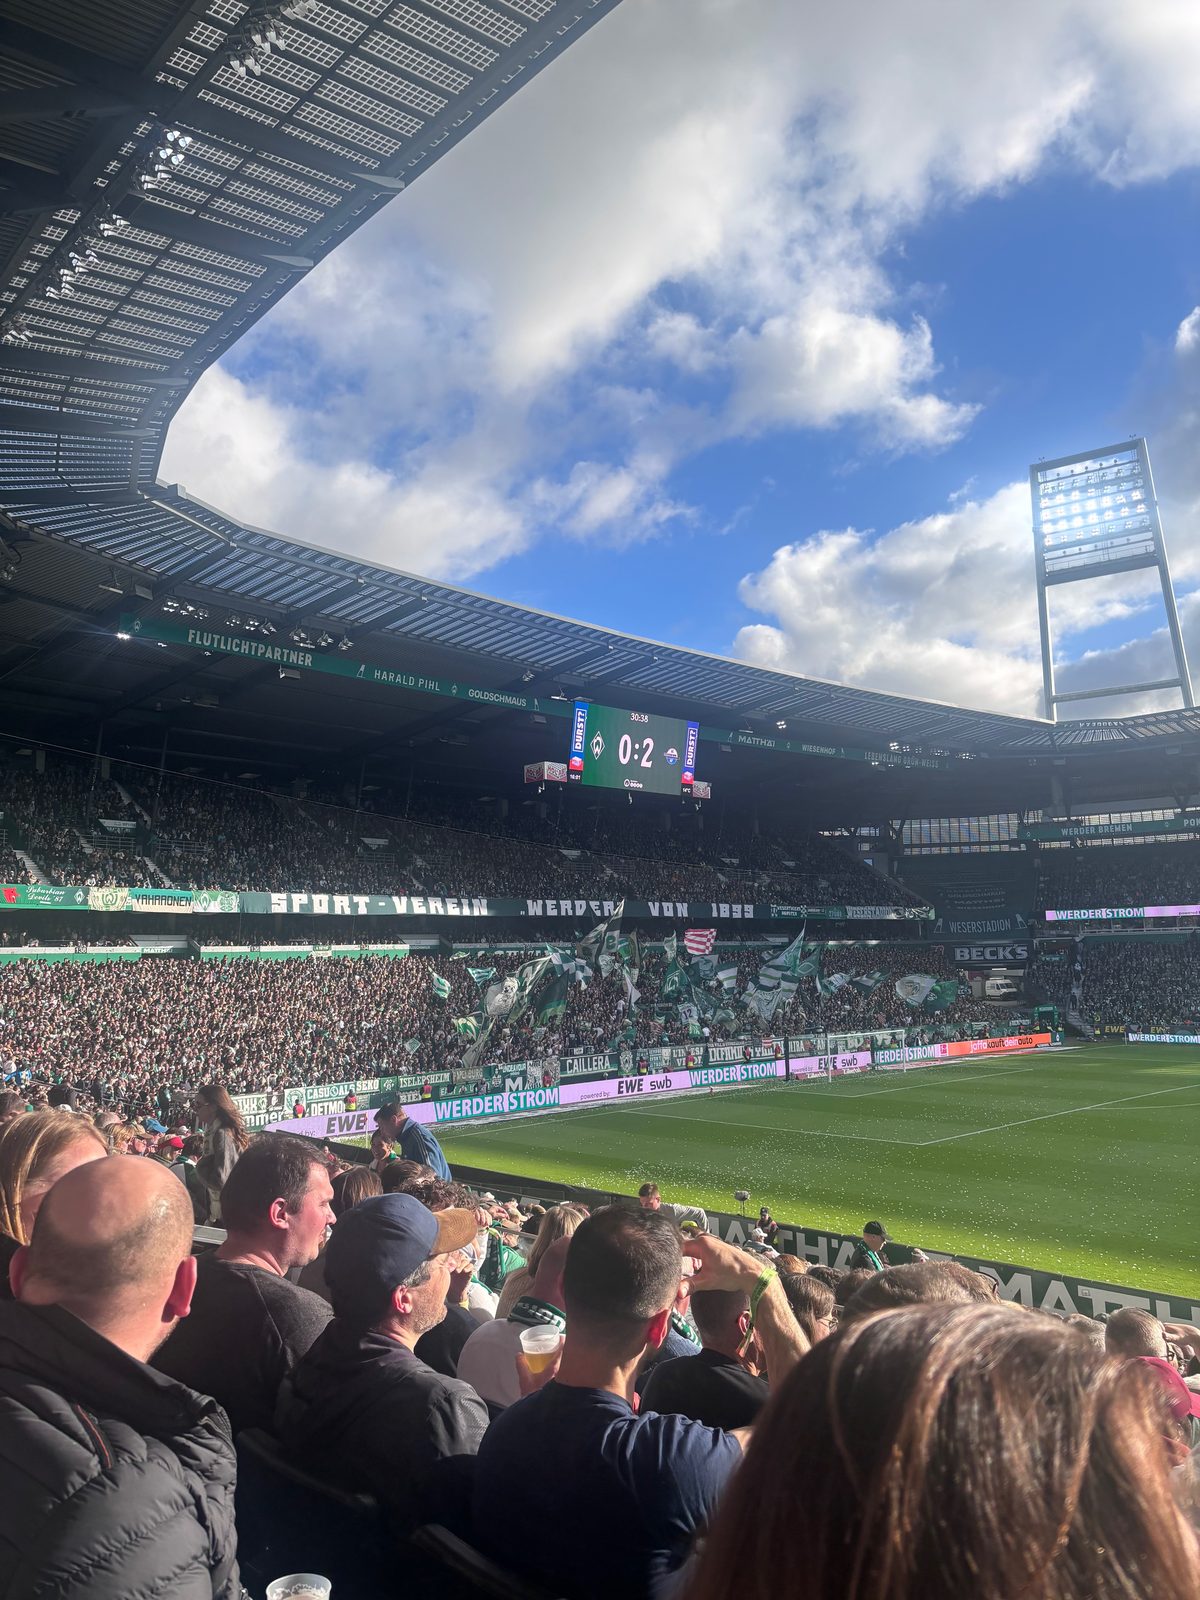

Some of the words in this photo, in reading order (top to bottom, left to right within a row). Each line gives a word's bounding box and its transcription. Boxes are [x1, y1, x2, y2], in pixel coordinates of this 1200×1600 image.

[188, 629, 313, 667] FLUTLICHTPARTNER
[374, 669, 415, 686] HARALD
[418, 678, 441, 692] PIHL
[468, 688, 527, 707] GOLDSCHMAUS
[574, 711, 586, 750] DURST?
[618, 734, 655, 768] 0:2
[686, 729, 697, 766] DURST?
[801, 743, 836, 756] WIESENHOF
[1061, 825, 1096, 836] WERDER
[1098, 823, 1133, 834] BREMEN
[648, 901, 689, 918] VON
[711, 902, 754, 919] 1899
[948, 918, 1011, 933] WESERSTADION
[954, 944, 1028, 961] BECK'S
[1104, 1025, 1126, 1033] EWE
[566, 1055, 611, 1074] CAILLERA
[841, 1054, 858, 1068] swb
[356, 1079, 380, 1092] SEKO
[617, 1078, 644, 1095] EWE
[650, 1075, 672, 1090] swb
[326, 1113, 367, 1134] EWE
